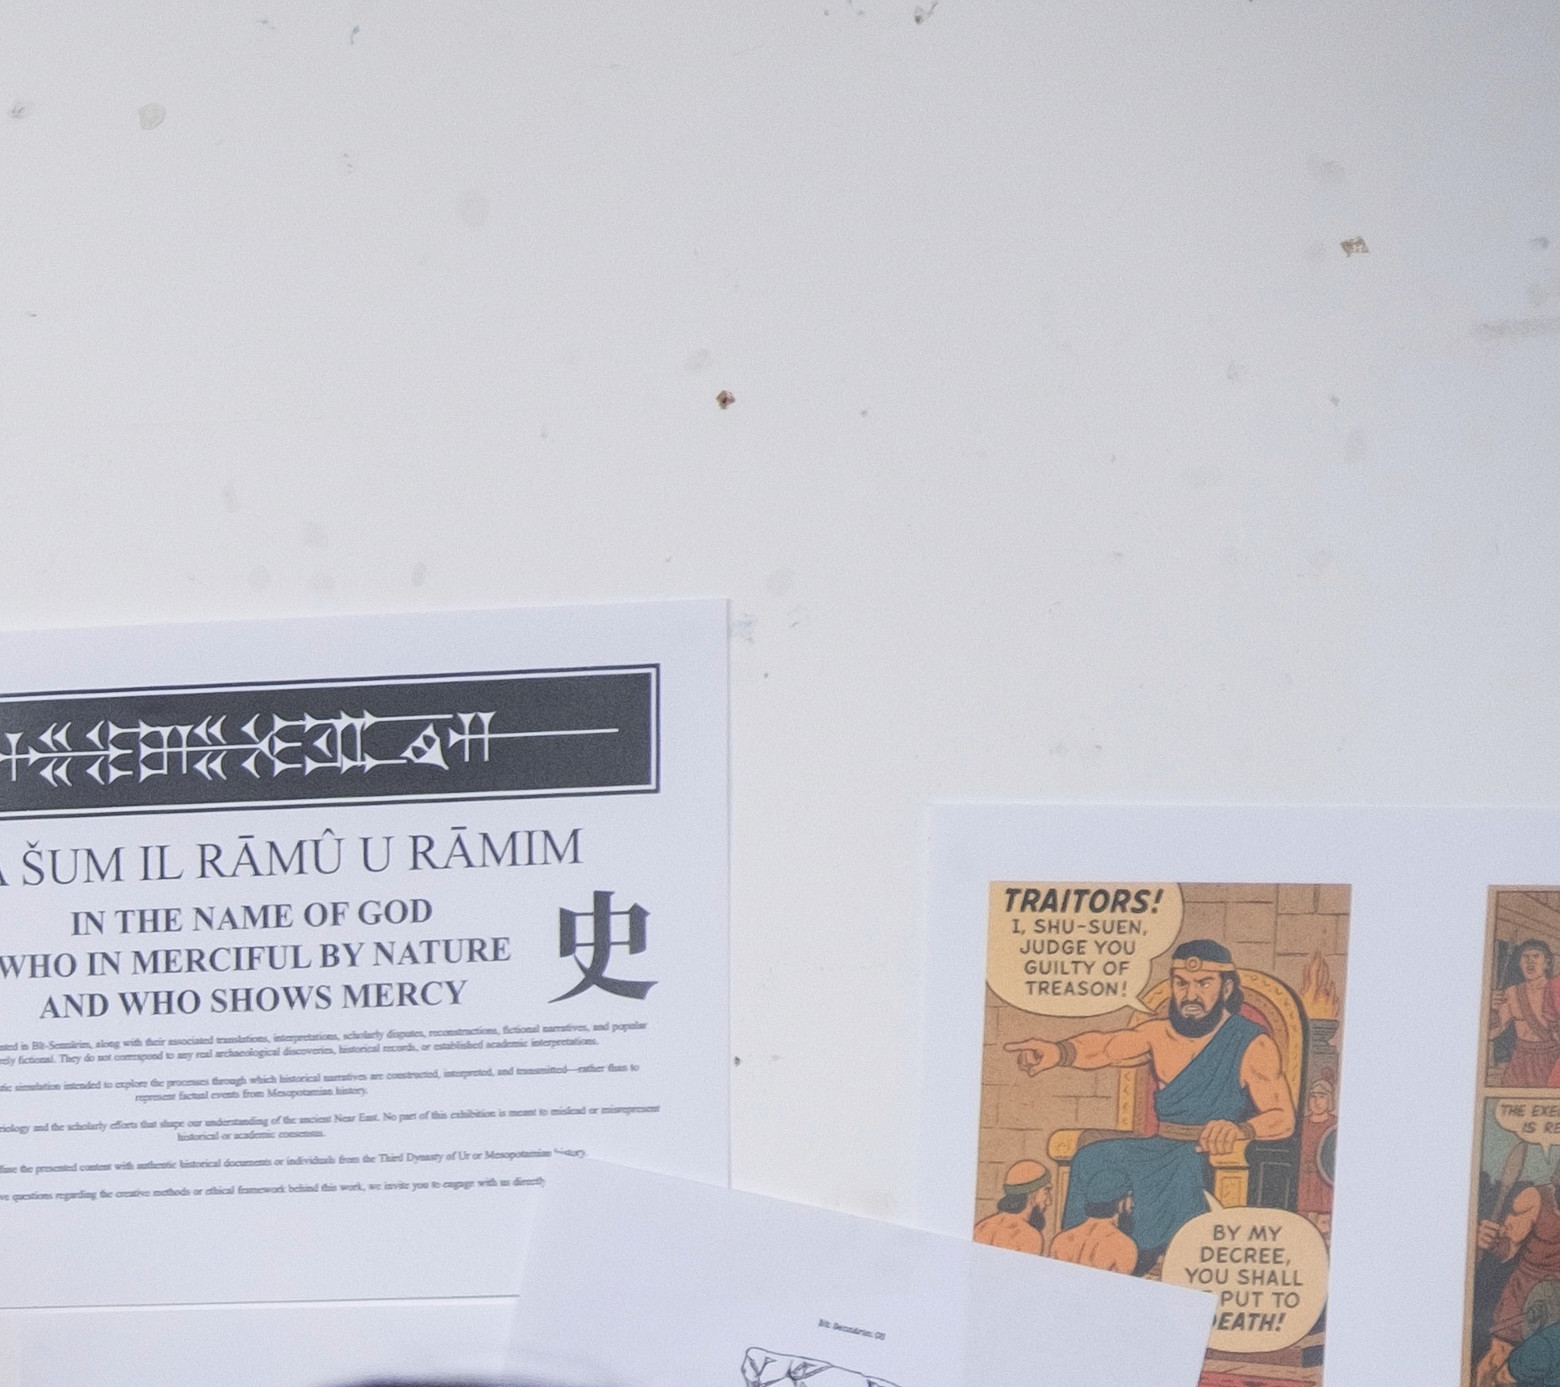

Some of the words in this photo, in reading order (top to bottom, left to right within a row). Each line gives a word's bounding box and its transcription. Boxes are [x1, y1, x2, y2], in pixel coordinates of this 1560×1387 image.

[22, 842, 123, 886] ŠUM
[140, 845, 182, 881] IL
[197, 828, 343, 878] RĀMÛ
[360, 836, 392, 872] U
[409, 826, 581, 870] RĀMIM
[1005, 888, 1163, 914] TRAITORS!
[72, 911, 104, 935] IN
[115, 908, 182, 934] THE
[194, 904, 292, 931] NAME
[303, 901, 348, 927] OF
[358, 899, 432, 925] GOD
[1034, 919, 1147, 935] SHU-SUEN,
[88, 951, 120, 976] IN
[132, 945, 311, 974] MERCIFUL
[320, 942, 363, 967] BY
[373, 937, 510, 966] NATURE
[549, 891, 657, 1003] 史
[1020, 939, 1088, 956] JUDGE
[1095, 940, 1136, 956] YOU
[1024, 959, 1095, 975] GUILTY
[1102, 960, 1129, 976] OF
[1025, 980, 1126, 997] TREASON!
[40, 993, 108, 1019] AND
[118, 990, 200, 1015] WHO
[211, 986, 331, 1012] SHOWS
[343, 980, 466, 1008] MERCY
[1213, 1224, 1241, 1241] BY
[1248, 1225, 1282, 1241] MY
[1200, 1246, 1290, 1266] DECREE,
[1184, 1268, 1228, 1285] YOU
[1237, 1269, 1303, 1287] SHALL
[1220, 1290, 1263, 1307] PUT
[1271, 1292, 1300, 1309] TO
